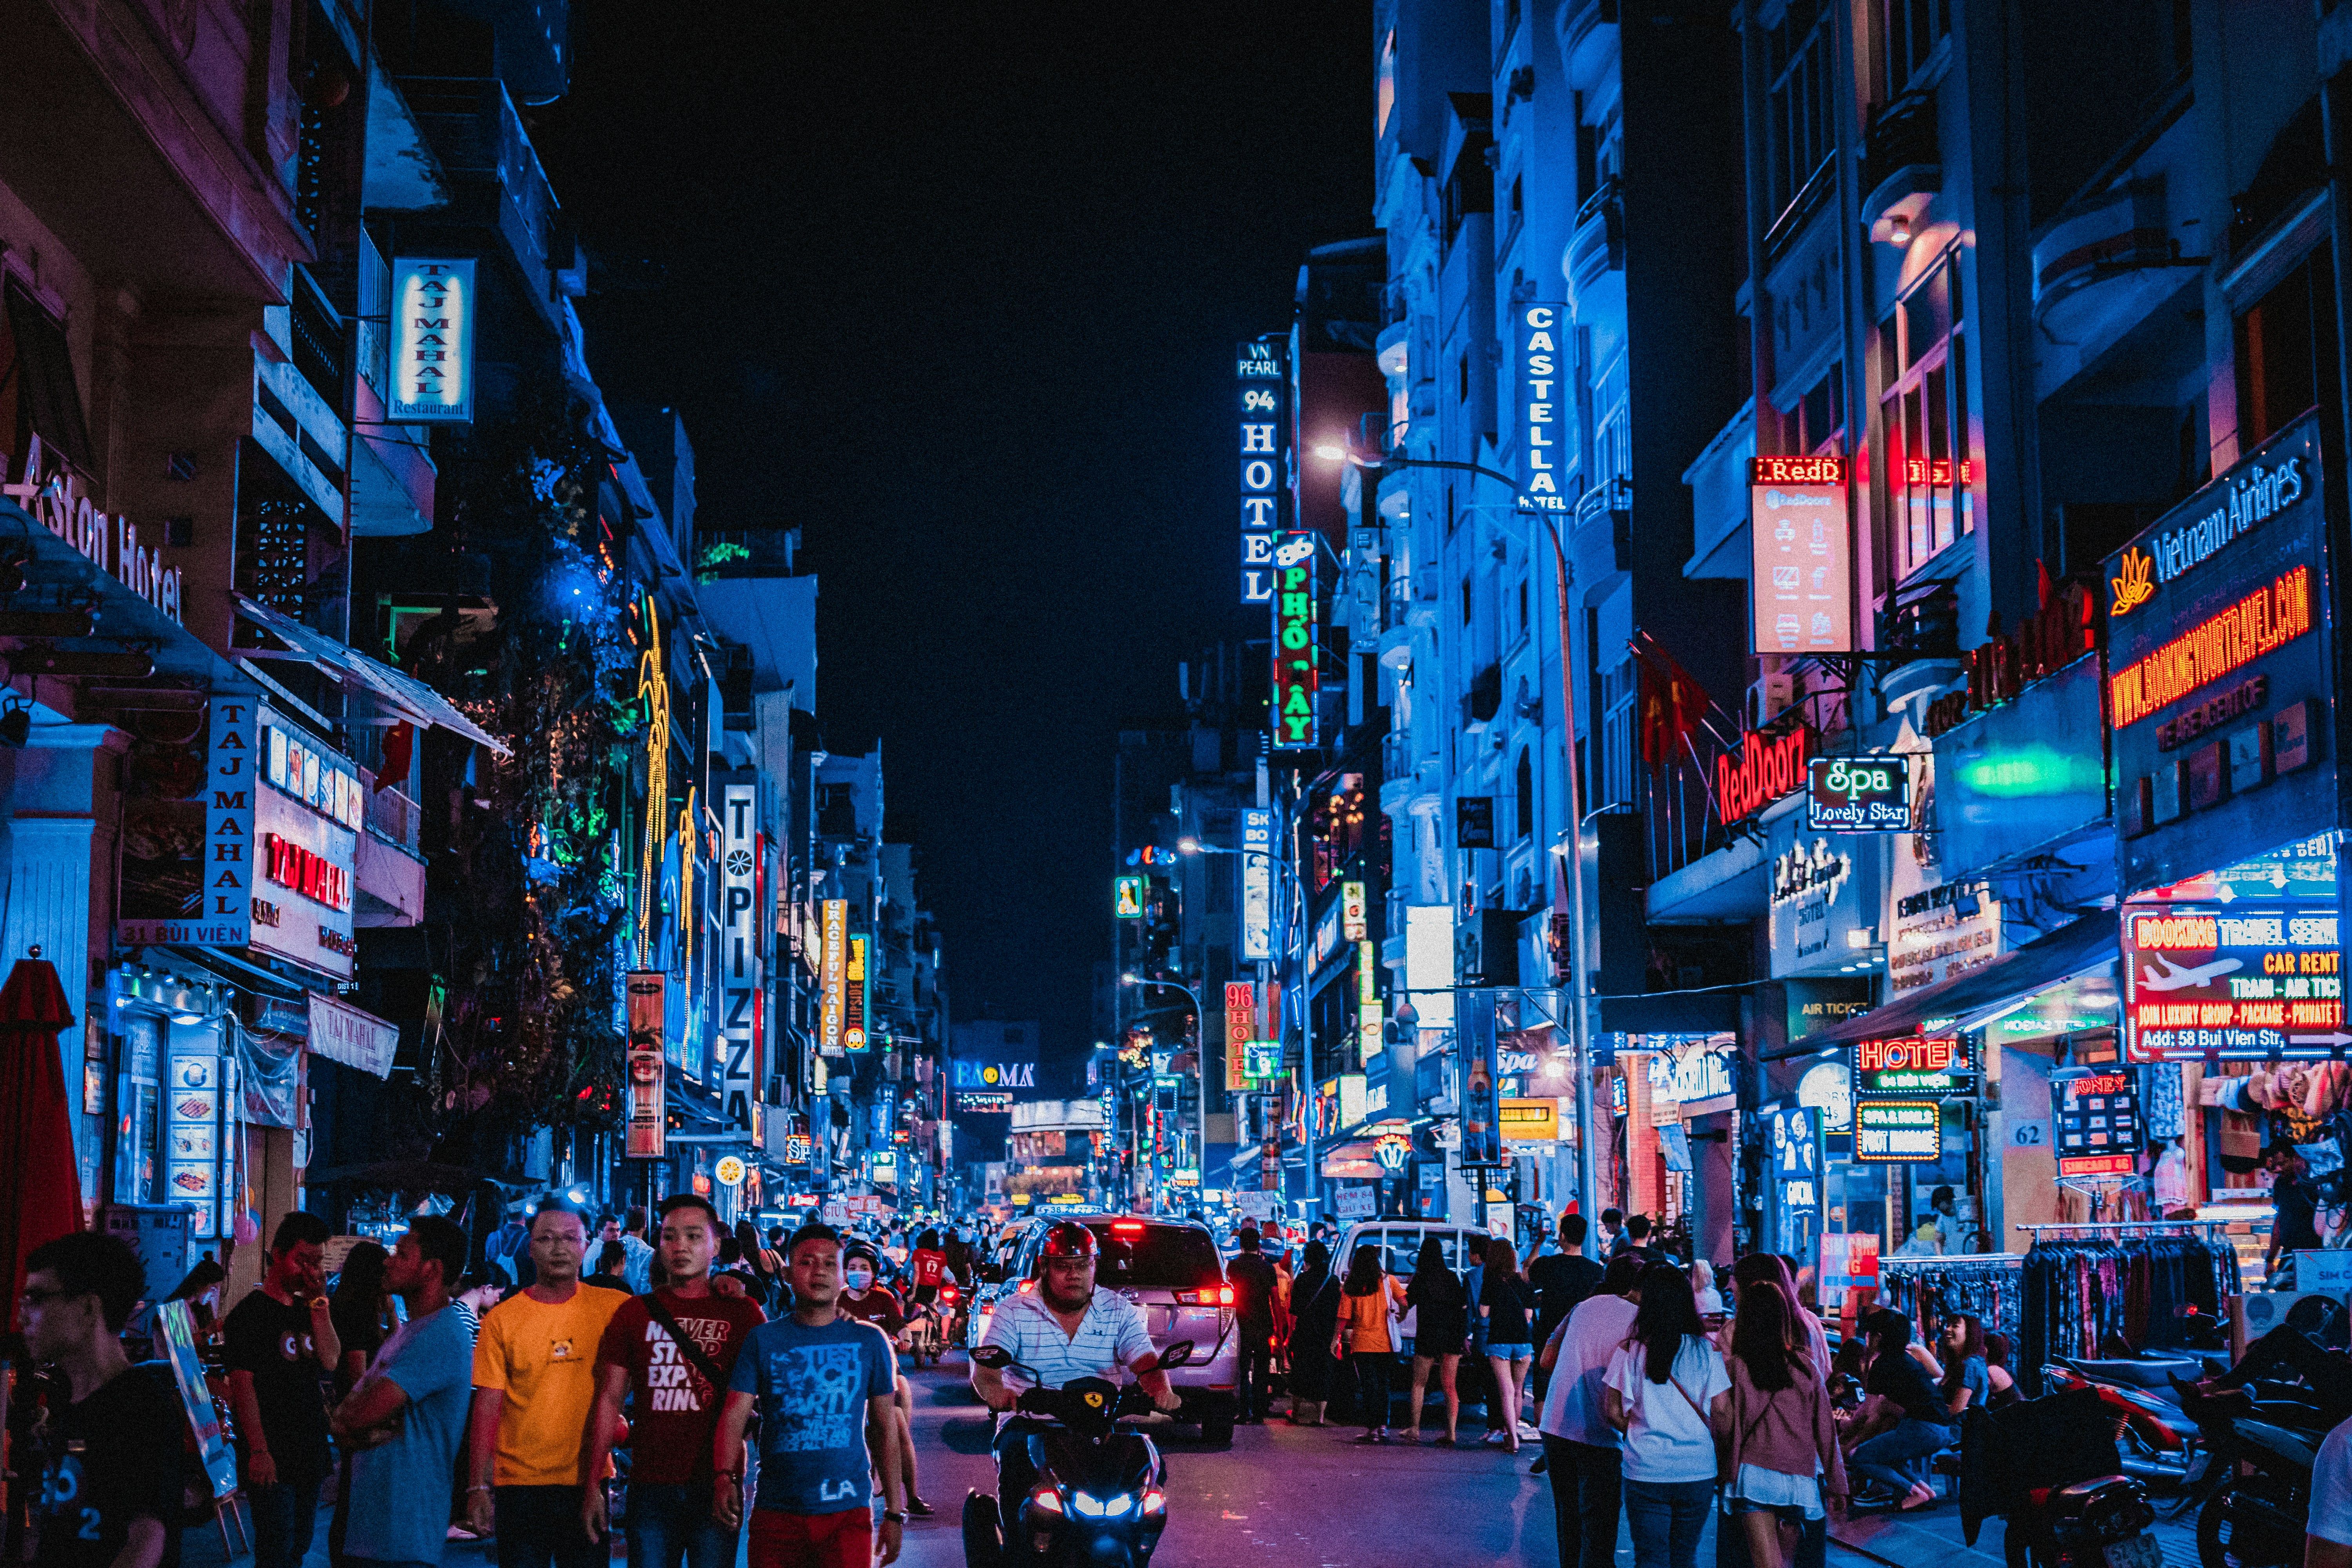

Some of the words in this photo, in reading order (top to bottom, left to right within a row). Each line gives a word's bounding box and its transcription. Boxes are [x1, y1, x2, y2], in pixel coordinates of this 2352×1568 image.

[417, 264, 450, 308] TAJ
[414, 318, 451, 394] MAHAL
[1250, 344, 1270, 359] VN
[1240, 360, 1279, 375] PEARL
[394, 399, 464, 415] Restaurant
[1244, 390, 1275, 411] 94
[1527, 308, 1556, 492] CASTELLA
[1243, 425, 1275, 600] HOTEL
[2152, 507, 2227, 583] Vietnam
[2229, 457, 2302, 539] Airlines
[217, 704, 248, 776] TAJ
[1718, 728, 1807, 823] RedDoorz
[1826, 761, 1891, 800] Spa
[1814, 802, 1866, 823] Lovely
[1870, 802, 1905, 821] Star
[214, 791, 247, 915] MAHAL
[828, 900, 841, 982] GRACEFUL
[2136, 916, 2218, 950] BOOKING
[2264, 953, 2295, 975] CAR
[2301, 953, 2340, 975] RENT
[1227, 984, 1253, 1008] 96
[2284, 978, 2310, 999] AIR
[826, 984, 840, 1045] SAIGON
[1802, 1003, 1822, 1014] AIR
[1826, 1002, 1868, 1014] TICK
[2139, 1000, 2160, 1027] JOIN
[2161, 1000, 2199, 1027] LUXURY
[2201, 1000, 2233, 1027] GROUP
[2240, 1000, 2285, 1027] PACKAGE
[2291, 1000, 2332, 1027] PRIVATE
[1230, 1010, 1249, 1088] HOTEL
[2142, 1031, 2176, 1047] Add:
[2178, 1031, 2195, 1046] 58
[2199, 1030, 2222, 1046] Bui
[2225, 1030, 2256, 1046] Vien
[2259, 1029, 2285, 1048] Str,
[2015, 1124, 2039, 1146] 62
[820, 1479, 857, 1501] LA
